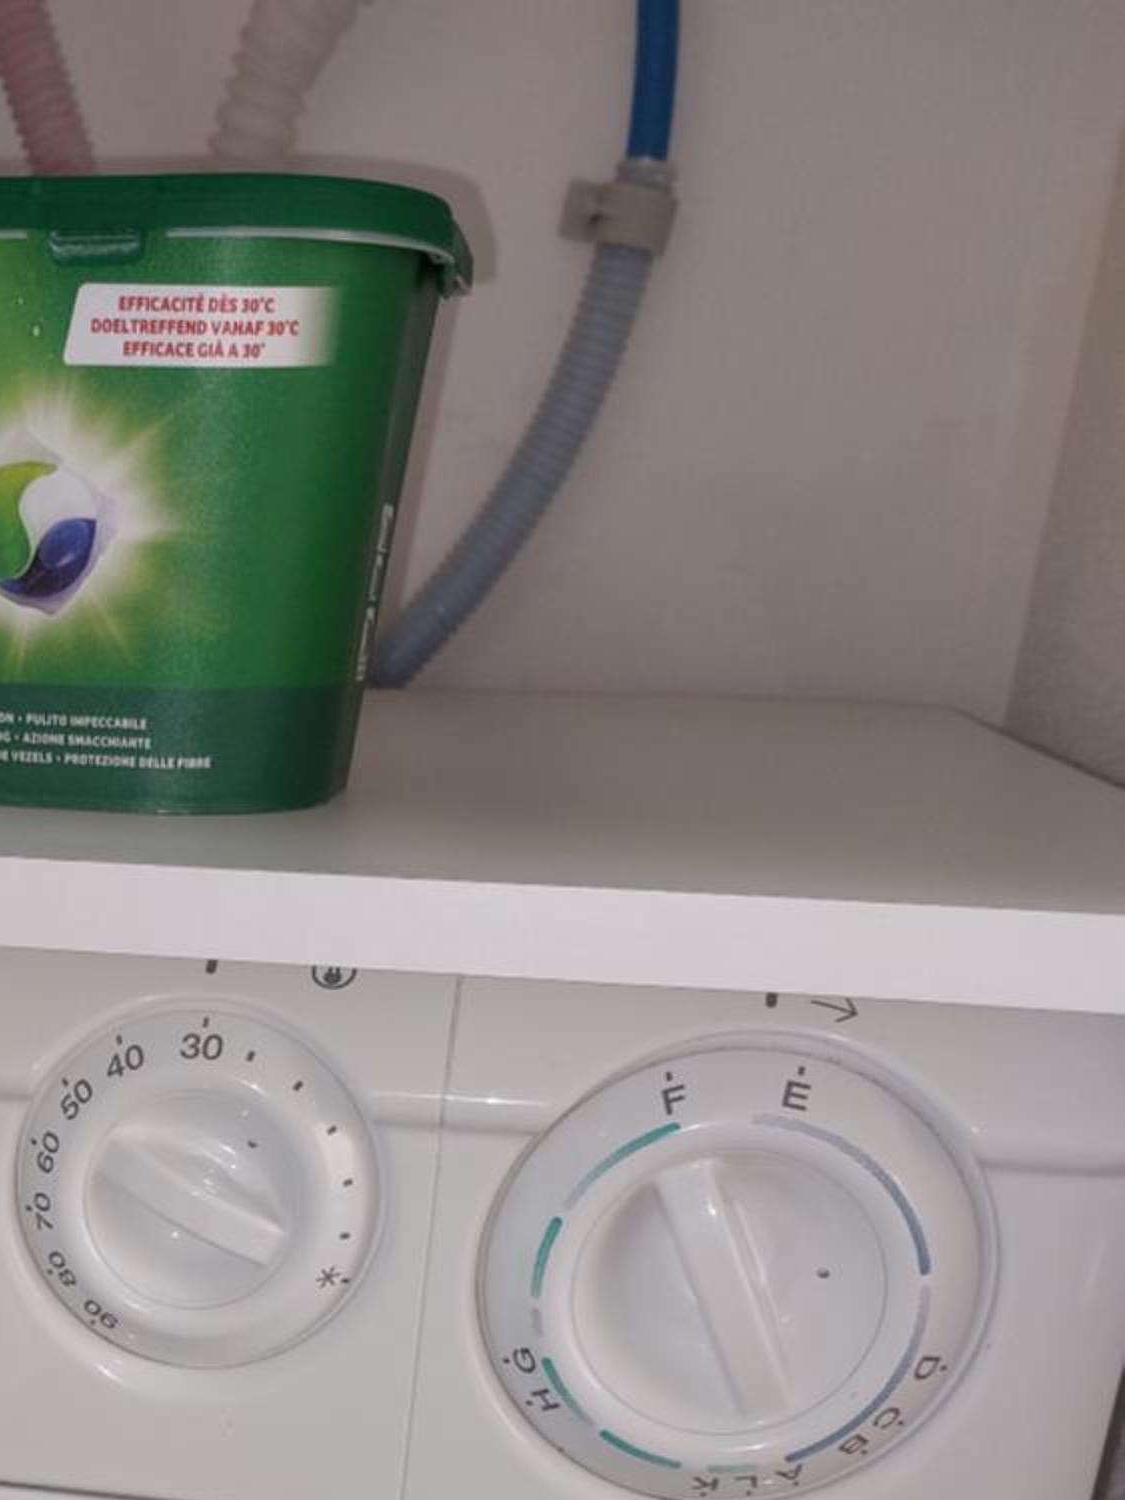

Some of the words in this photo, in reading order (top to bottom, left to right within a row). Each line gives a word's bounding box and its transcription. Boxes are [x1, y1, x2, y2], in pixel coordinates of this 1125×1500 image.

[118, 293, 205, 313] EFFICACITÉ
[208, 294, 238, 313] DÈS
[241, 297, 275, 313] 30°C
[90, 318, 207, 336] DOELTREFFEND
[210, 320, 263, 336] VANAF
[266, 320, 300, 336] 30°C
[122, 341, 195, 358] EFFICACE
[198, 340, 224, 358] GIÀ
[227, 342, 239, 358] A
[242, 342, 266, 358] 30°
[26, 713, 68, 726] PULITO
[70, 715, 148, 731] IMPECCABILE
[23, 733, 64, 746] AZIONE
[68, 734, 152, 750] SMACCHIANTE
[11, 751, 53, 764] VEZELS
[64, 753, 137, 768] PROTEZIONE
[139, 755, 176, 769] DELLE
[177, 756, 212, 769] FIBRE
[179, 1032, 224, 1061] 30
[106, 1043, 145, 1079] 40
[59, 1077, 94, 1120] 50
[661, 1083, 687, 1116] F
[781, 1079, 812, 1112] E
[36, 1130, 61, 1174] 60
[33, 1191, 54, 1231] 70
[47, 1250, 79, 1288] 80
[83, 1298, 120, 1330] 90
[512, 1347, 537, 1374] G
[914, 1355, 942, 1380] D
[530, 1387, 561, 1412] H
[872, 1406, 901, 1430] C
